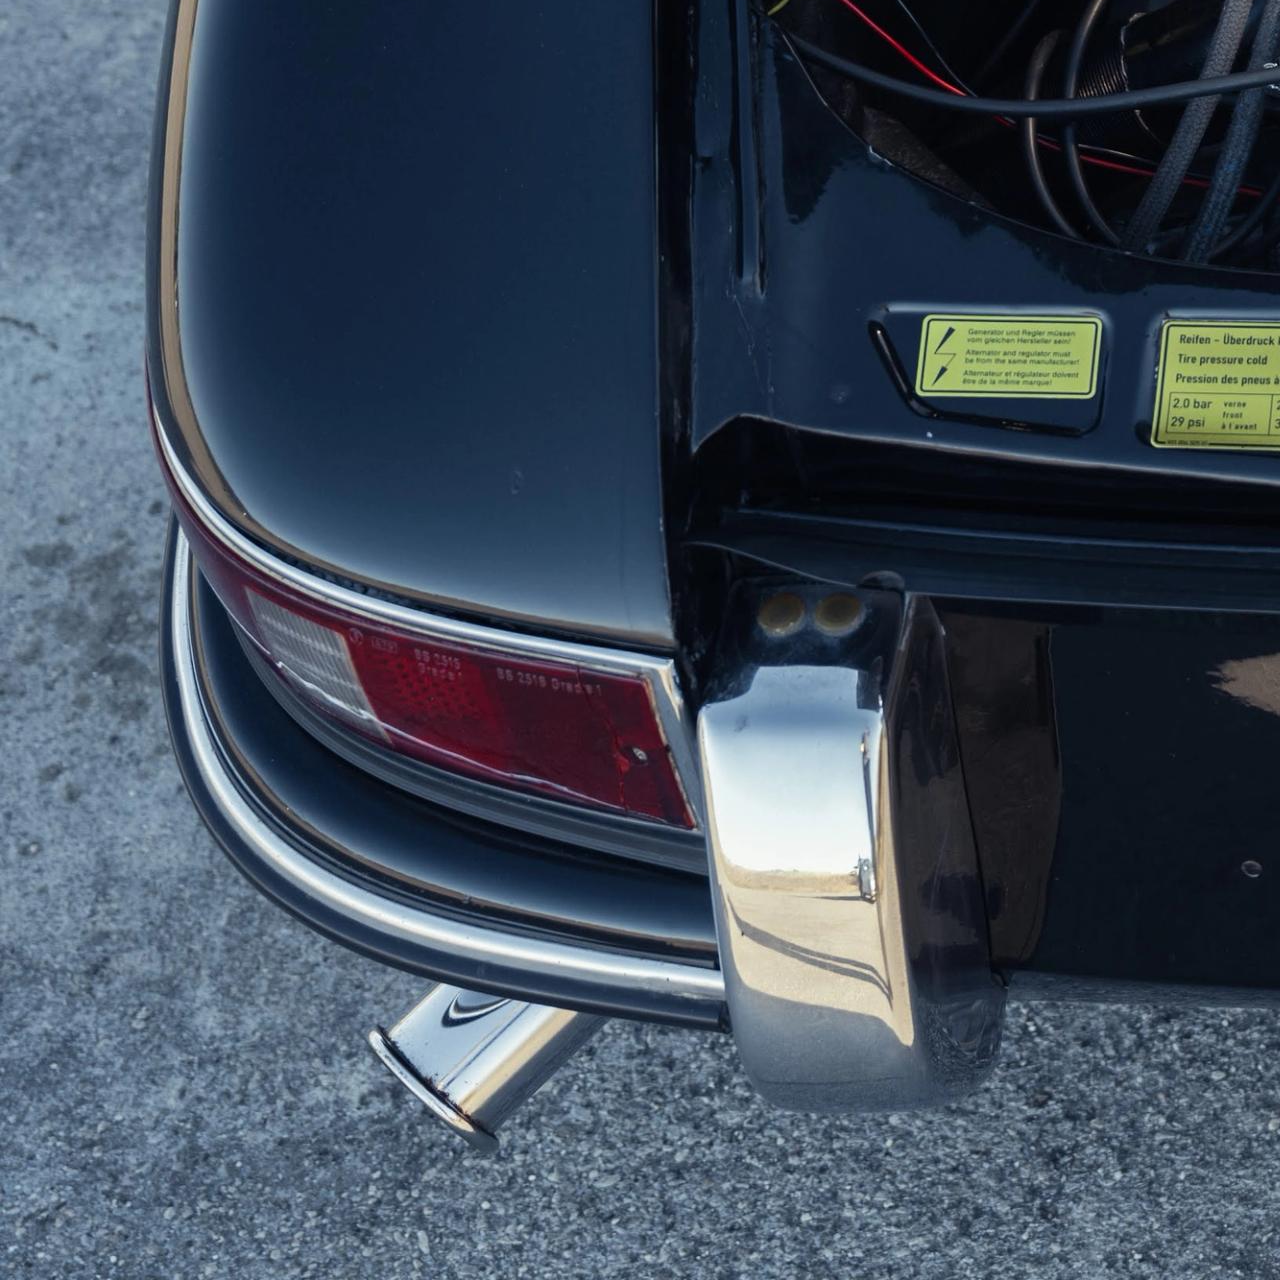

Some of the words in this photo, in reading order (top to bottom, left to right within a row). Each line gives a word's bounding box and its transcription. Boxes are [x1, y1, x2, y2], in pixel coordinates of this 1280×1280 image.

[968, 328, 1005, 336] Generator
[1006, 328, 1020, 336] und
[1022, 329, 1046, 338] Regler
[984, 337, 1015, 345] gleichen
[1017, 337, 1051, 345] Hersteller
[1179, 334, 1211, 345] Reifen
[1223, 332, 1275, 346] Überdruck
[965, 349, 1001, 357] Alternator
[1018, 350, 1050, 358] regulator
[1178, 353, 1197, 364] Tire
[1199, 355, 1244, 366] pressure
[1246, 355, 1268, 365] cold
[1175, 372, 1218, 384] Pression
[1221, 374, 1239, 384] des
[1241, 376, 1271, 386] pneus
[1273, 375, 1280, 385] à
[1172, 397, 1190, 409] 2.0
[1193, 398, 1213, 409] bar
[1223, 400, 1247, 408] vorne
[1222, 411, 1243, 419] front
[1170, 416, 1185, 427] 29
[1188, 417, 1206, 429] psi
